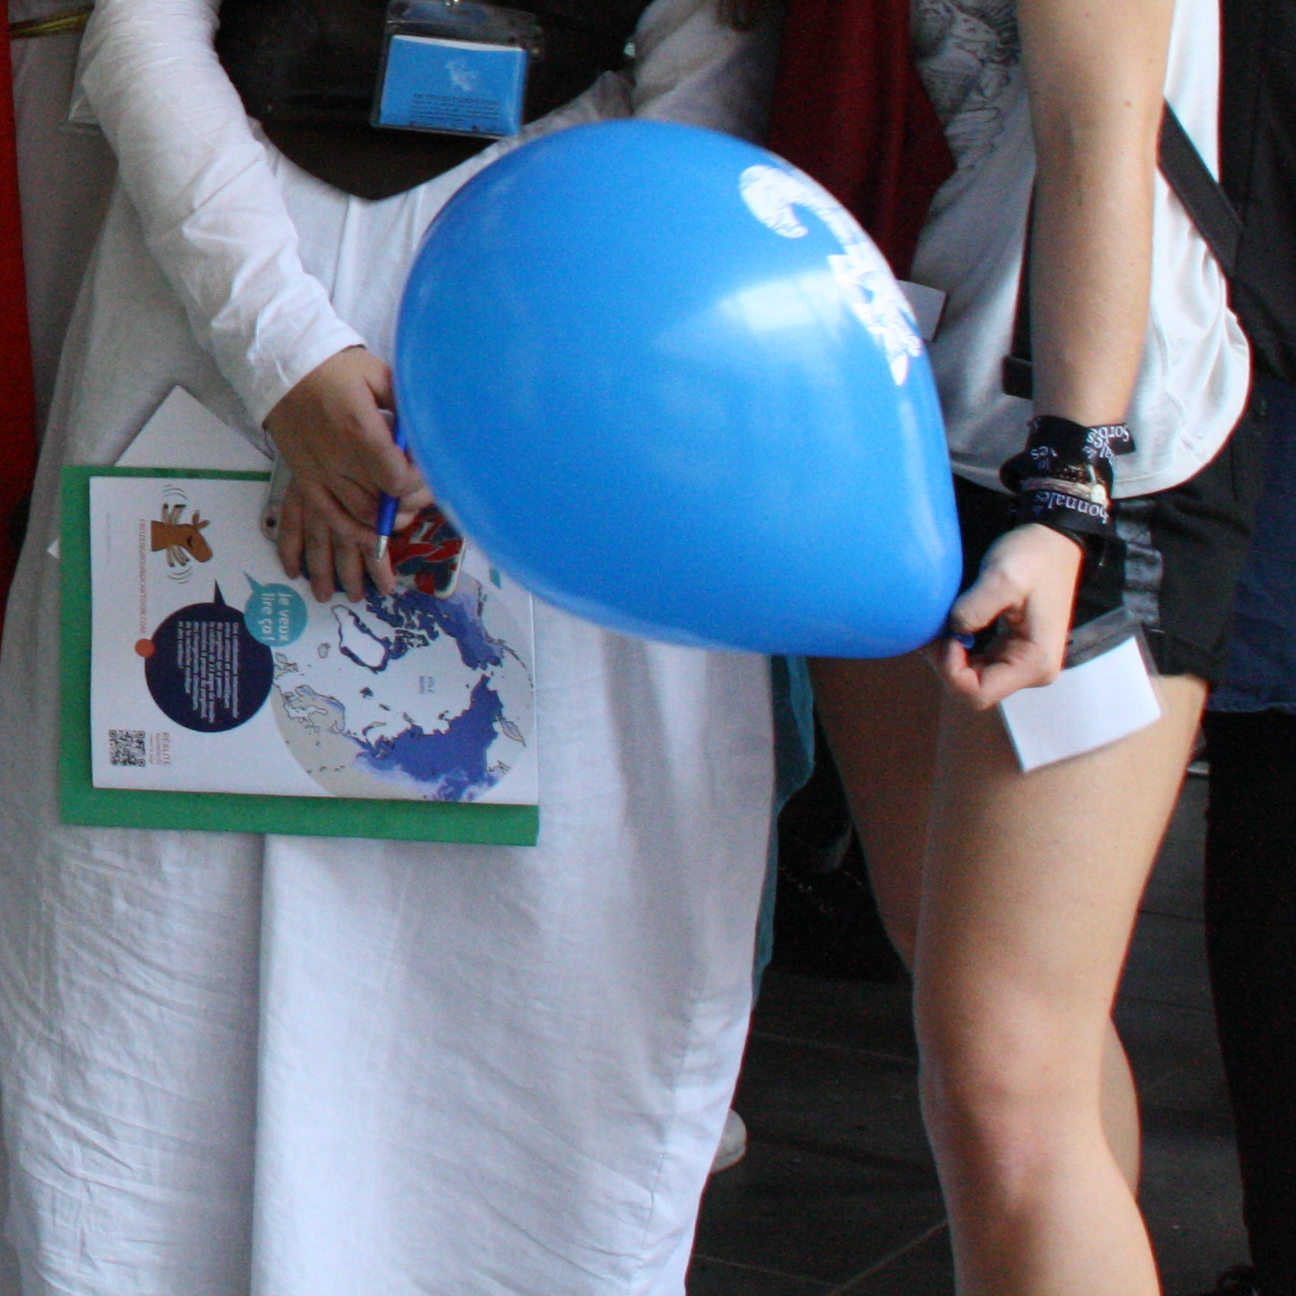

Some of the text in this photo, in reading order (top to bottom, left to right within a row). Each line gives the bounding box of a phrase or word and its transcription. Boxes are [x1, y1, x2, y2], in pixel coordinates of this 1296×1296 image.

[261, 593, 276, 615] lire
[277, 593, 292, 642] Je veux
